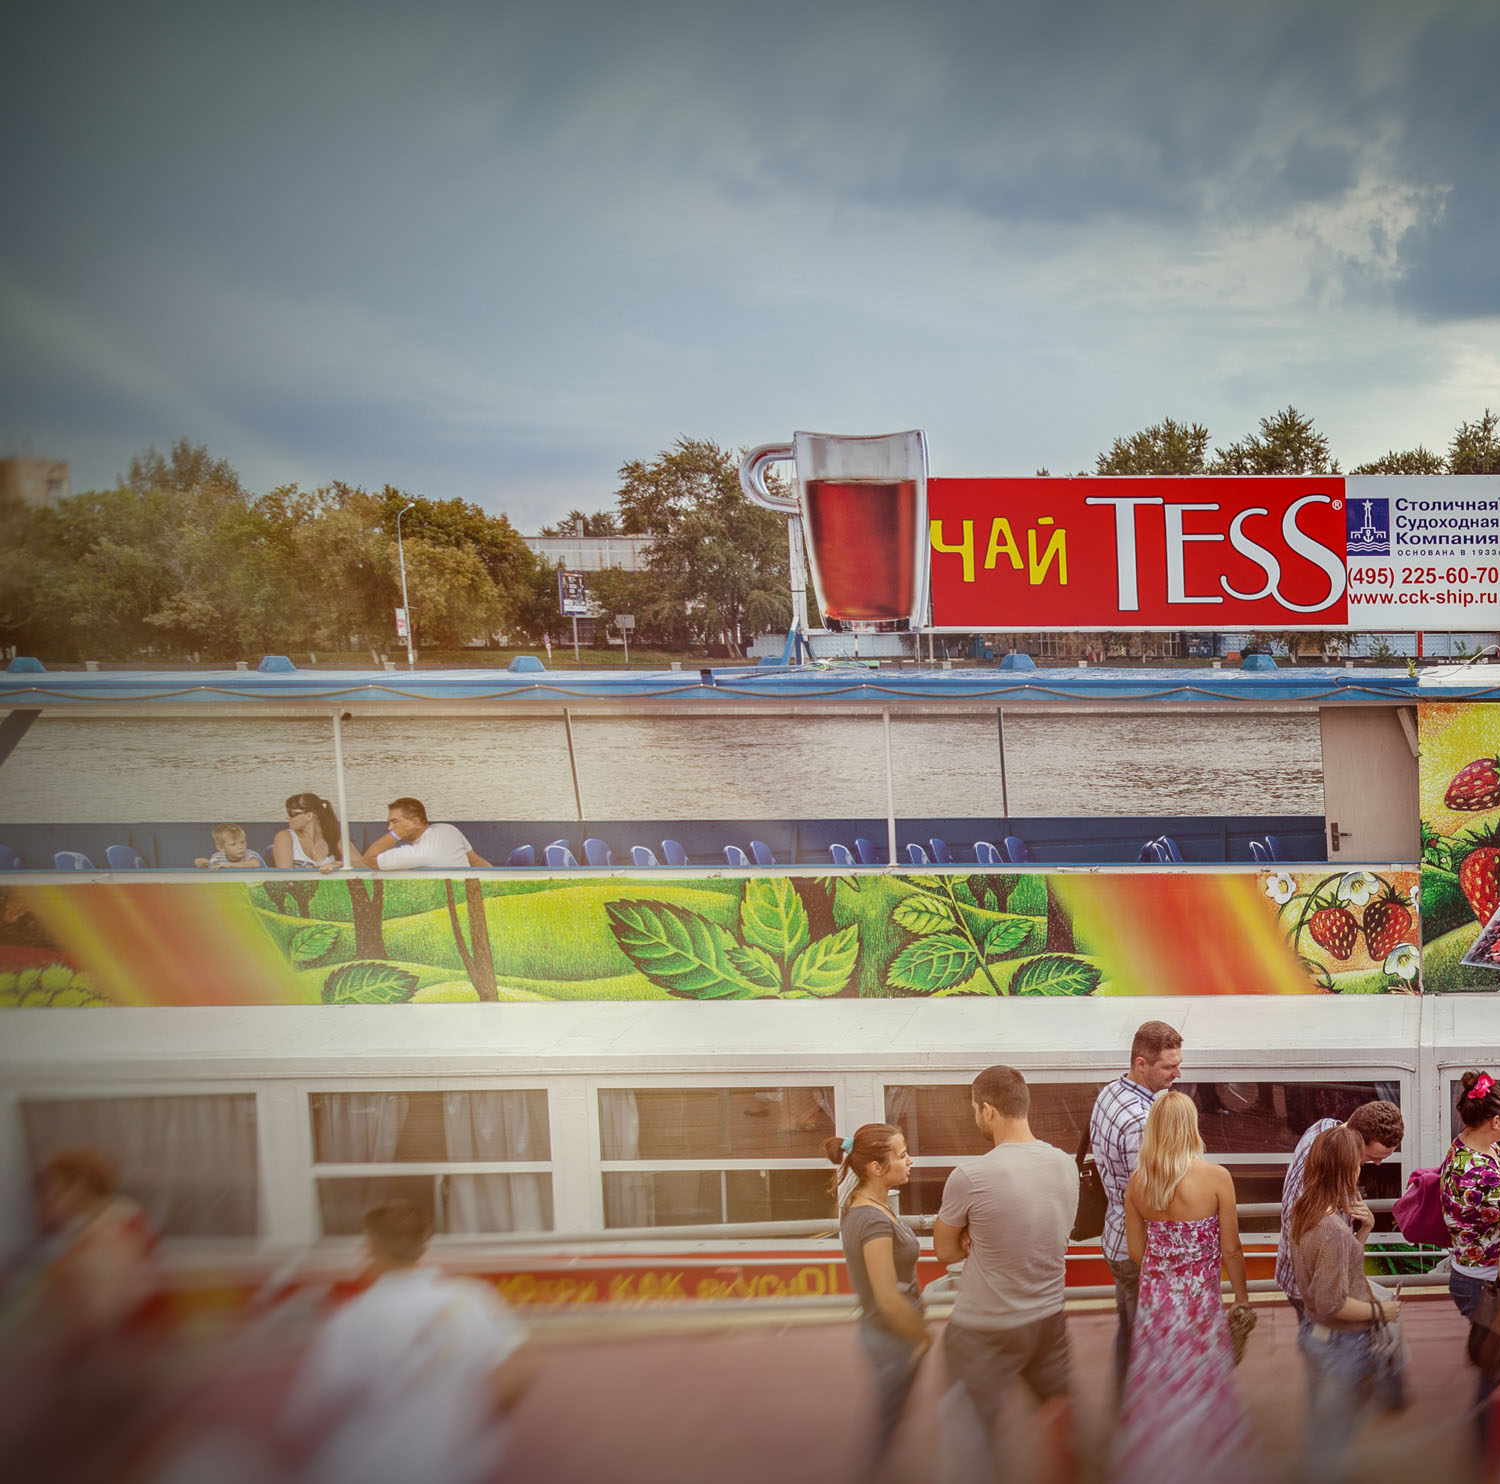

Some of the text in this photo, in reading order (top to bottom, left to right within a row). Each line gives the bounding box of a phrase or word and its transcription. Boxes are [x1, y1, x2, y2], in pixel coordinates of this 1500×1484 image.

[1395, 515, 1499, 531] Судоходная
[1396, 532, 1499, 545] Компания
[929, 517, 1068, 585] ЧАЙ
[1347, 567, 1499, 588] (495) 225-60-70
[1348, 589, 1498, 607] www.cck-ship.ru
